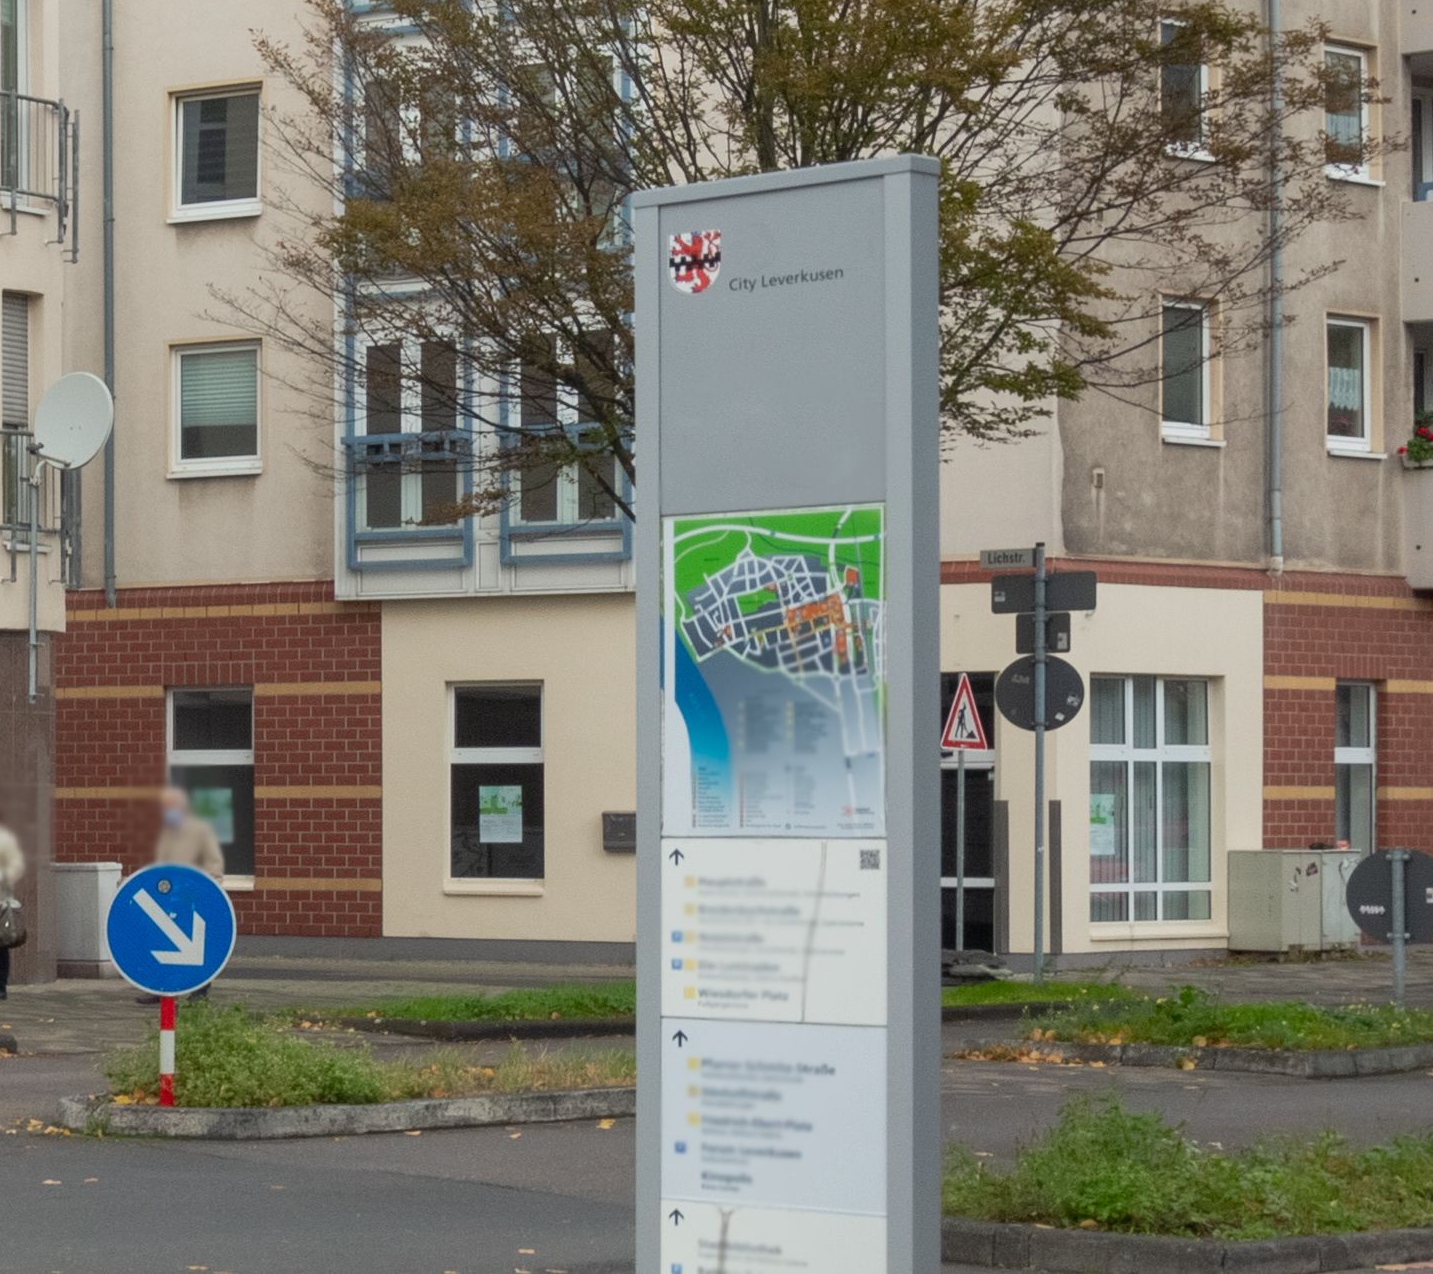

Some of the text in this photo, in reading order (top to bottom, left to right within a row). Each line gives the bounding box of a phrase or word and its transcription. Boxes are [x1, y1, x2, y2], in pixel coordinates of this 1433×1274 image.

[729, 268, 844, 292] City Leverkusen
[987, 552, 1026, 565] Lichstr.
